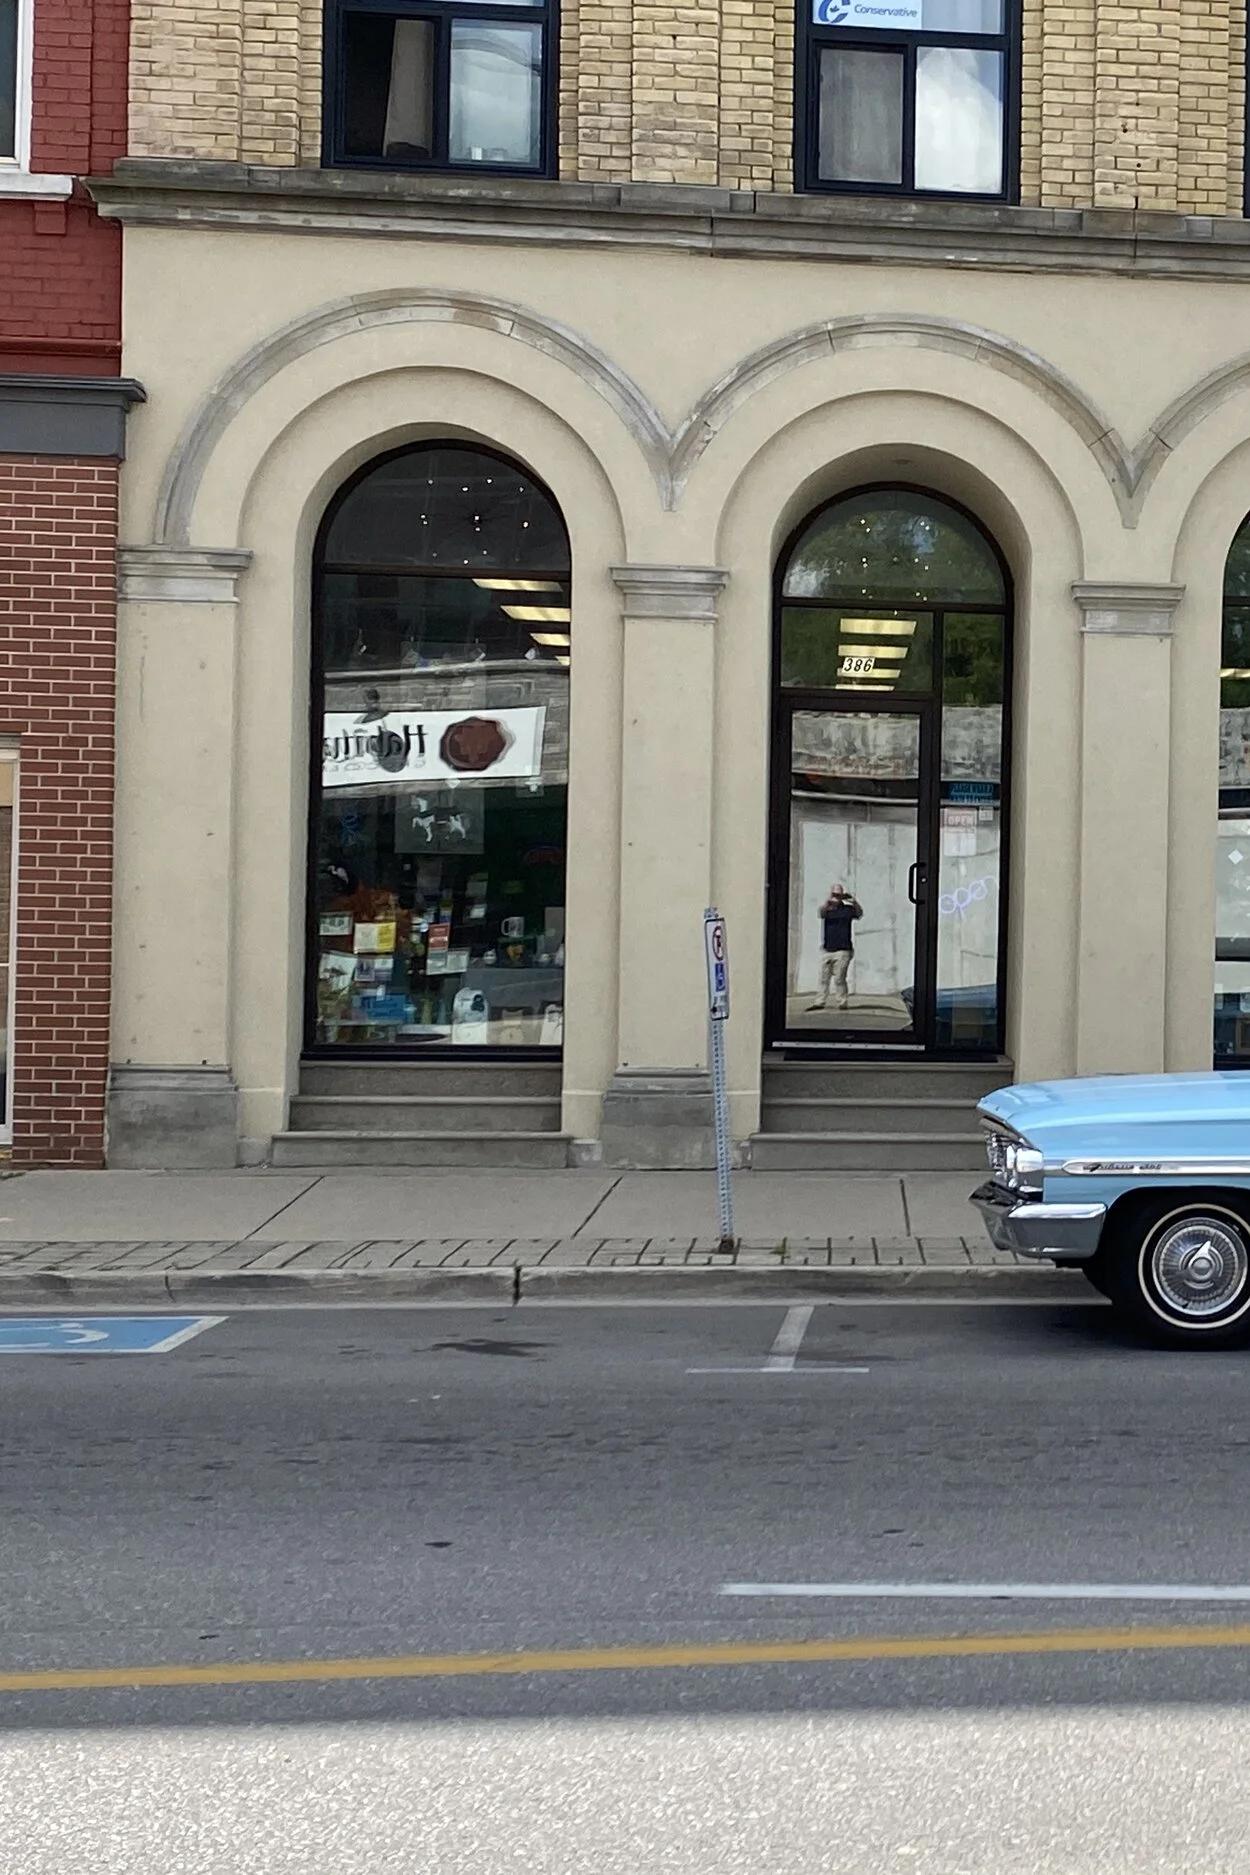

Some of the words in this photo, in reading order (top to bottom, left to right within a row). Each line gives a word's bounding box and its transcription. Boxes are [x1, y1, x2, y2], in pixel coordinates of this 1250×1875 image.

[854, 4, 918, 17] Conservative
[844, 657, 872, 672] 386
[948, 815, 973, 825] OPEN
